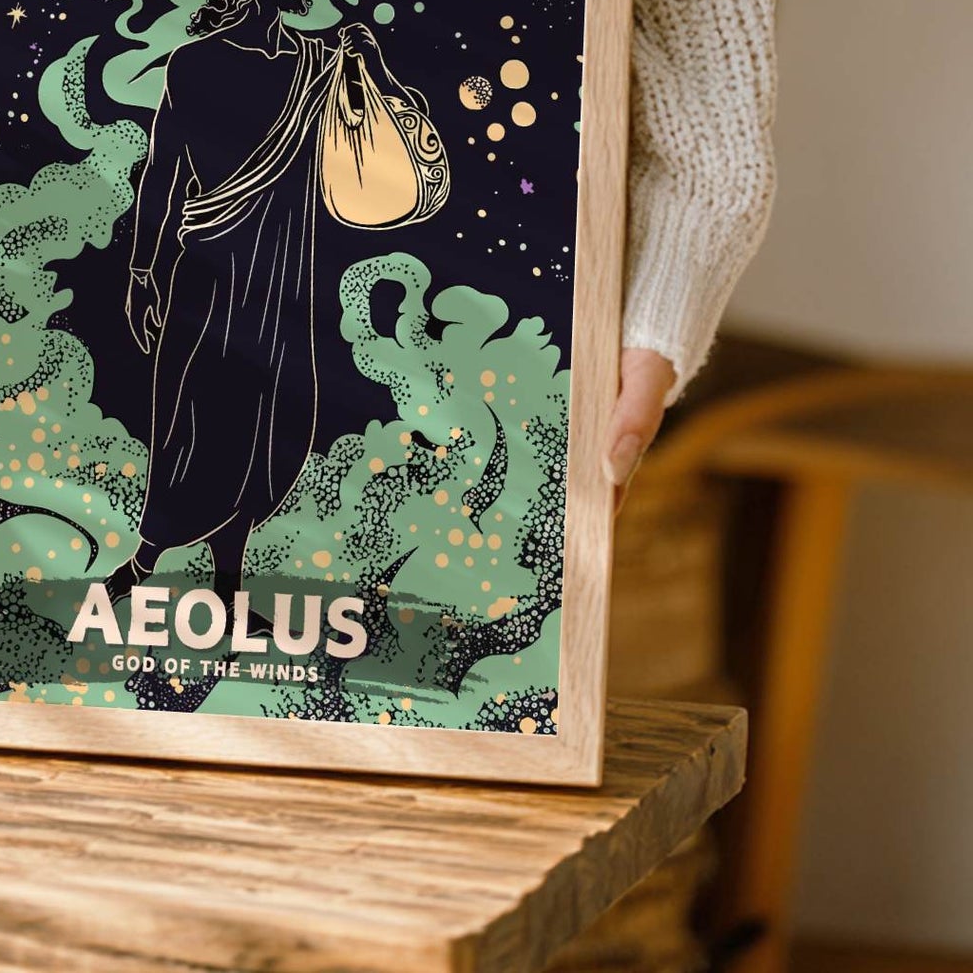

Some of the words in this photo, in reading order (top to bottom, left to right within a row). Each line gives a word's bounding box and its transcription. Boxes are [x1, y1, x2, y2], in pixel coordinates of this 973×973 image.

[67, 583, 368, 659] AEOLUS
[112, 655, 154, 672] GOD
[165, 657, 190, 674] OF
[200, 659, 240, 677] THE
[250, 662, 319, 682] WINDS
